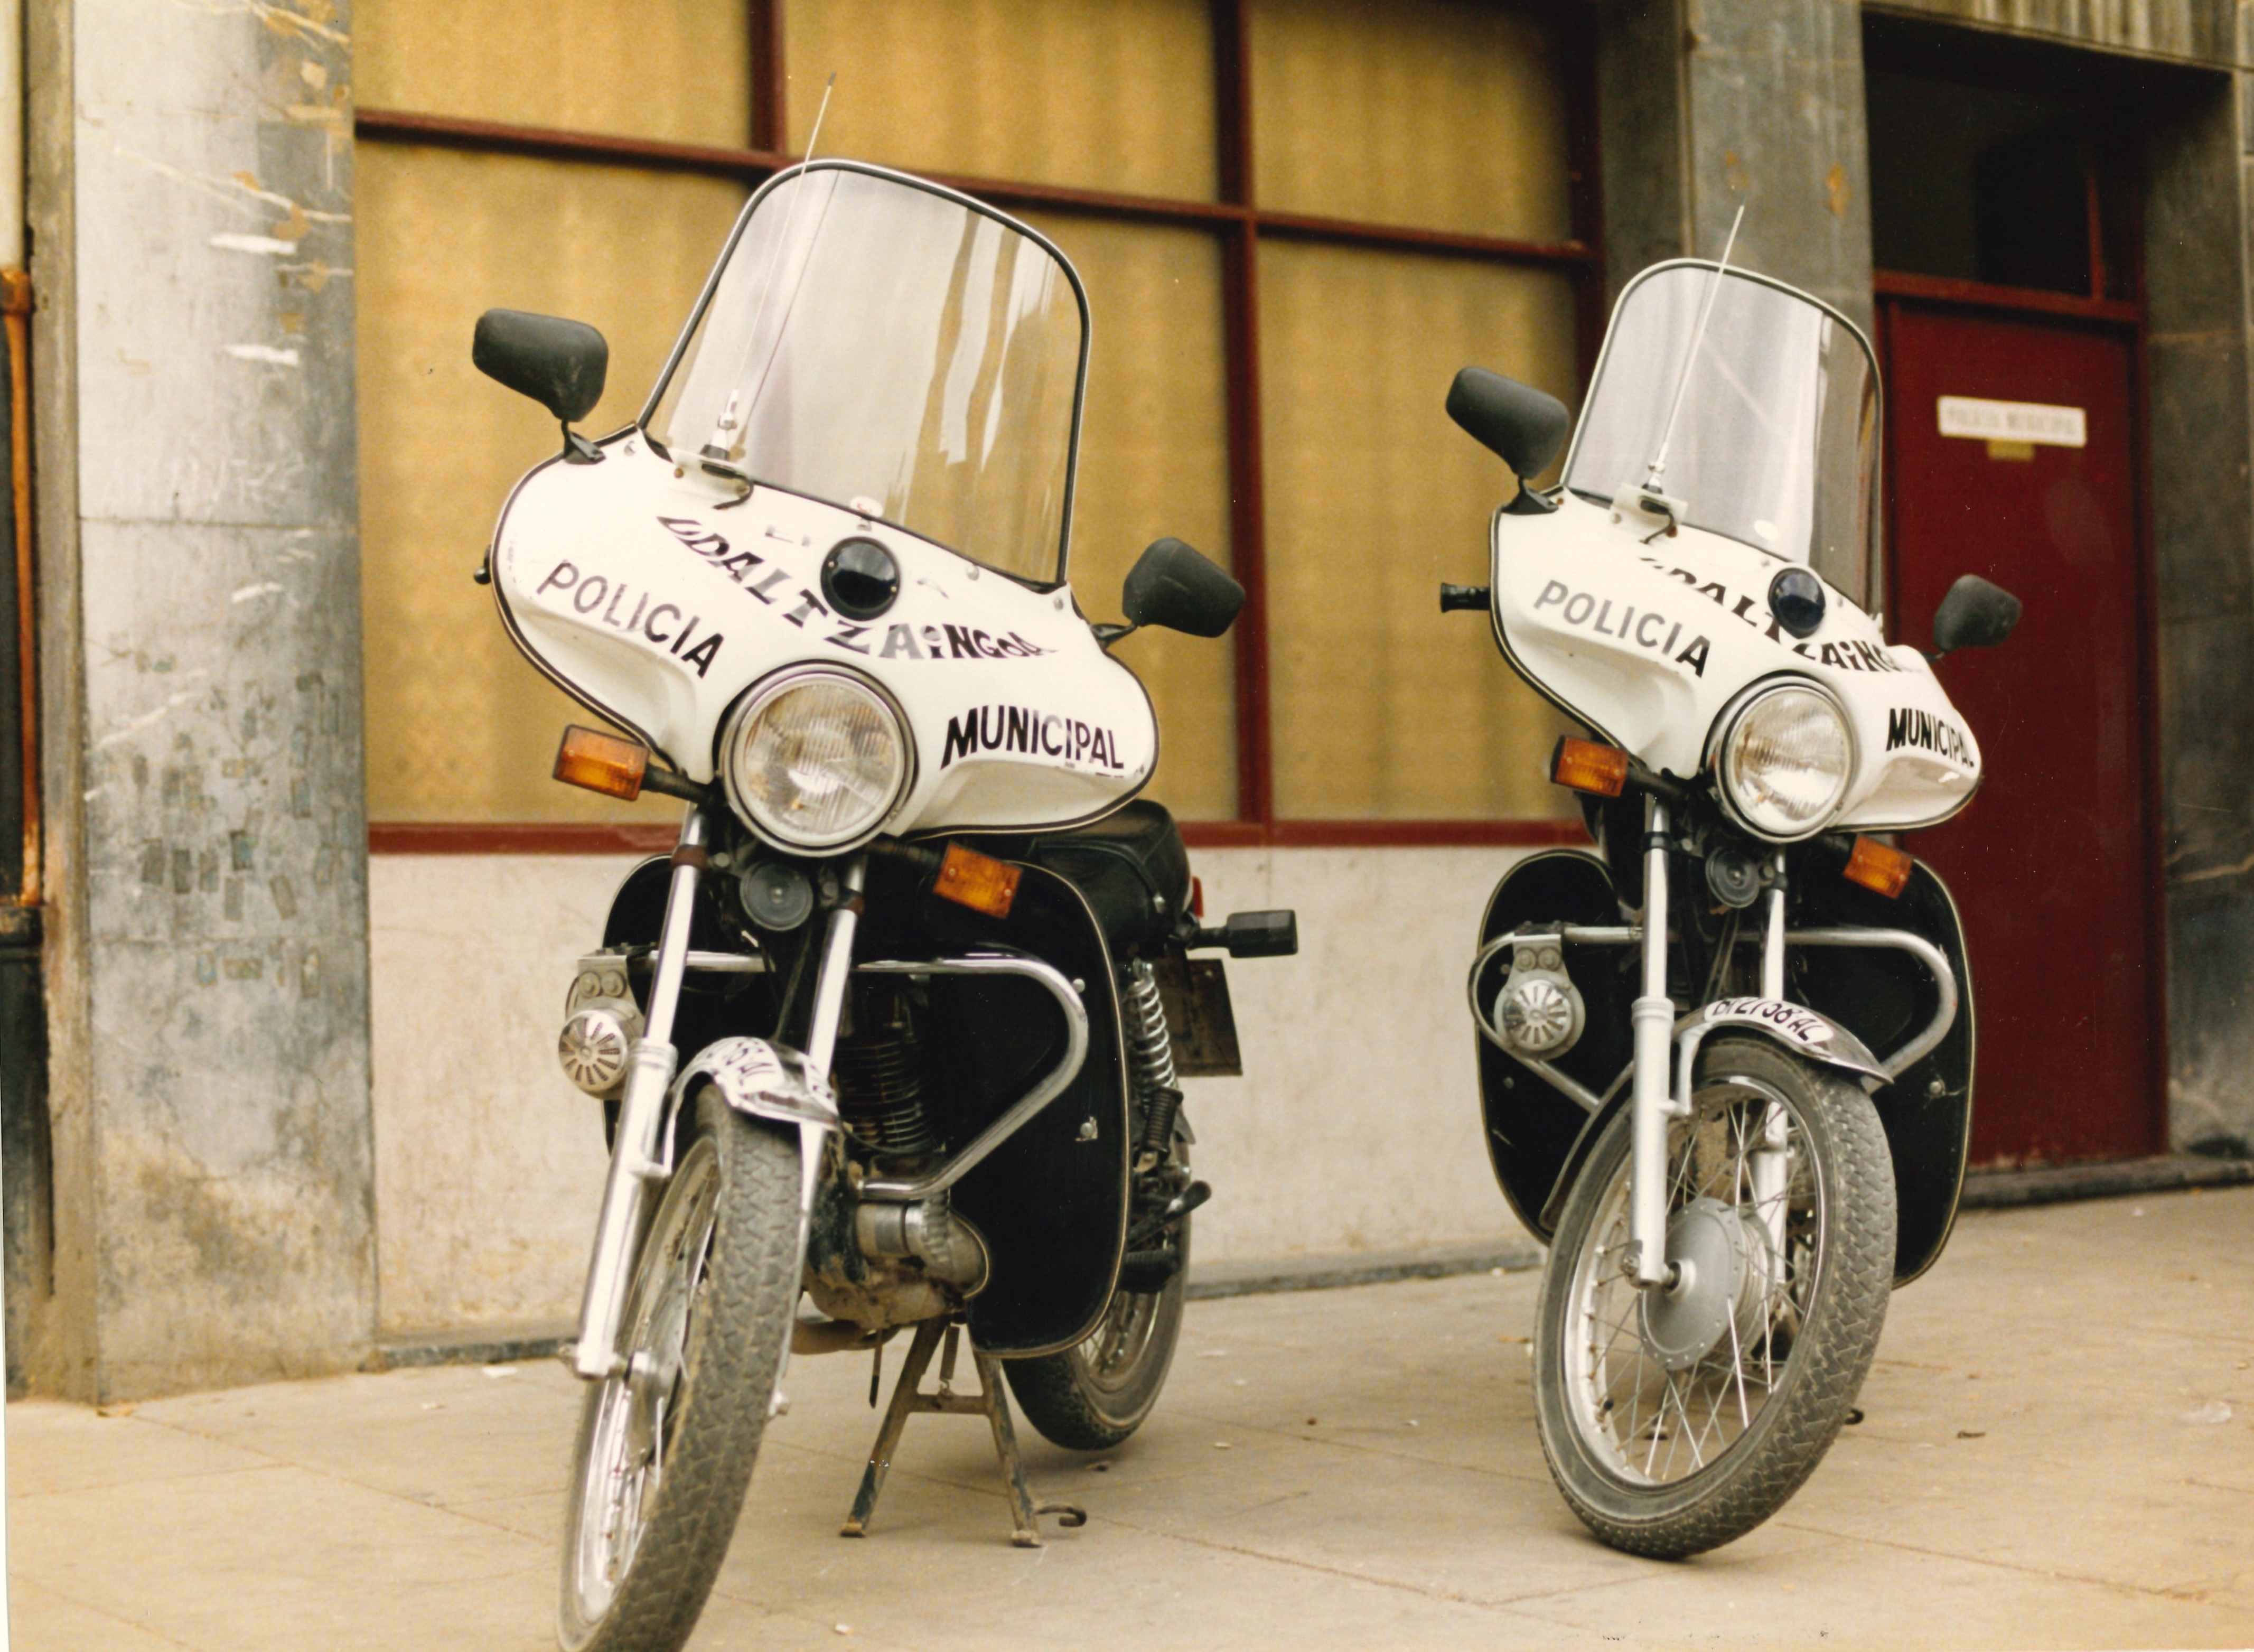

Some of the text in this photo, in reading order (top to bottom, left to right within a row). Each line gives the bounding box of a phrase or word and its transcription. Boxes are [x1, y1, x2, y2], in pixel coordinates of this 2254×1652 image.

[536, 560, 724, 678] POLICIA
[1533, 580, 1710, 678] POLICIA
[940, 705, 1124, 770] MUNICIPAL
